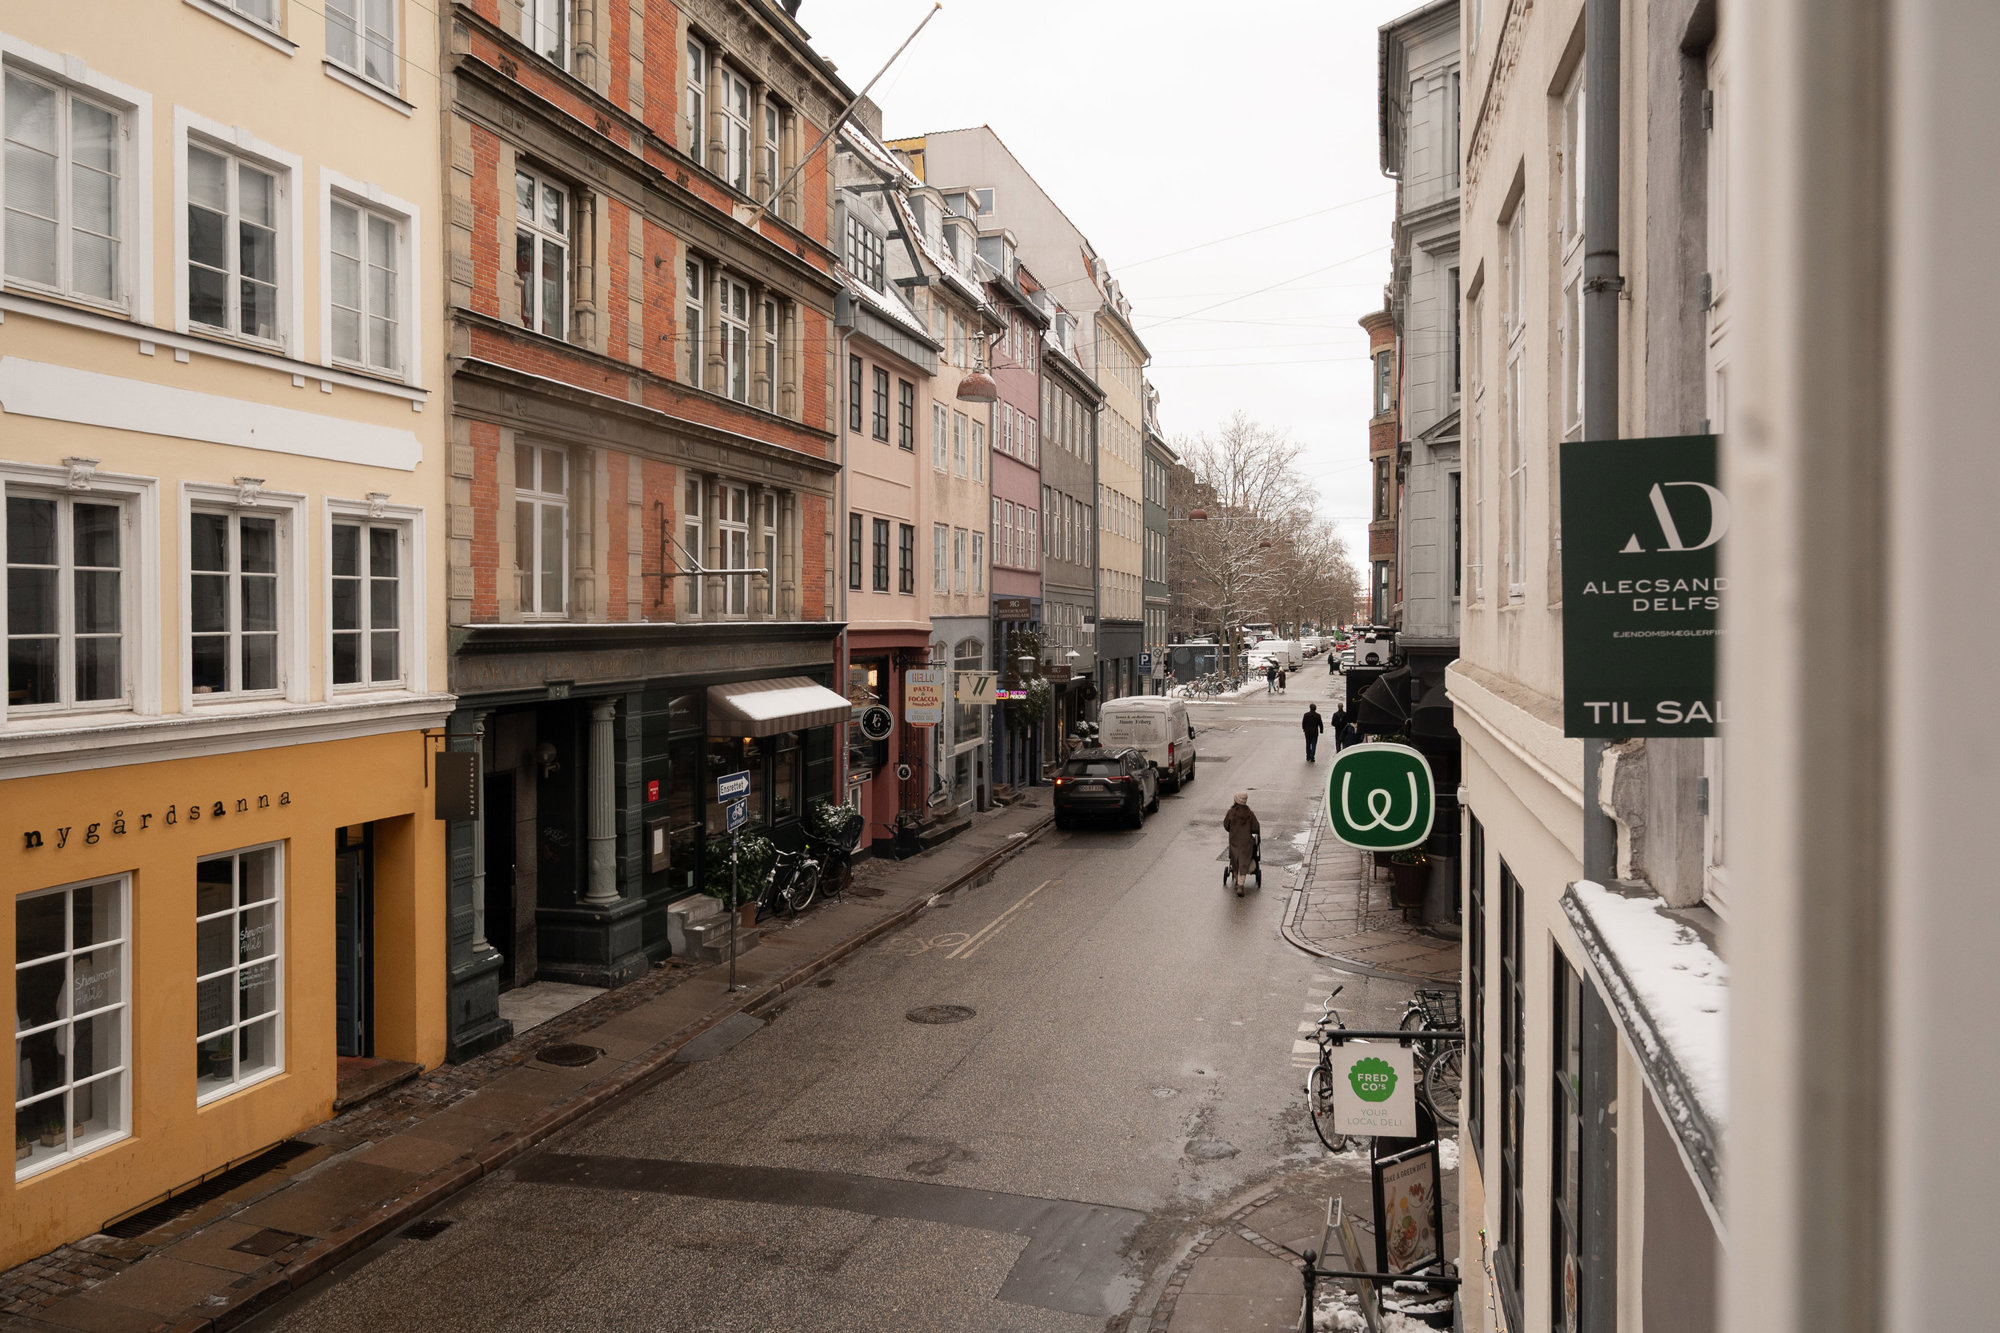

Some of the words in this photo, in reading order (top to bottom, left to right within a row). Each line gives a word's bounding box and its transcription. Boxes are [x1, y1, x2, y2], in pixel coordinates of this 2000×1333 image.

[1632, 596, 1720, 612] DELFS
[1141, 654, 1149, 665] P
[912, 672, 936, 682] HELLO
[1583, 701, 1646, 724] TIL
[720, 781, 744, 794] Ensrettet
[24, 791, 291, 848] nygårdsanna
[1357, 1073, 1388, 1082] FRED
[1360, 1108, 1388, 1117] YOUR
[1347, 1117, 1377, 1126] LOCAL
[1380, 1118, 1402, 1127] DELI
[1384, 1174, 1396, 1183] TAKE
